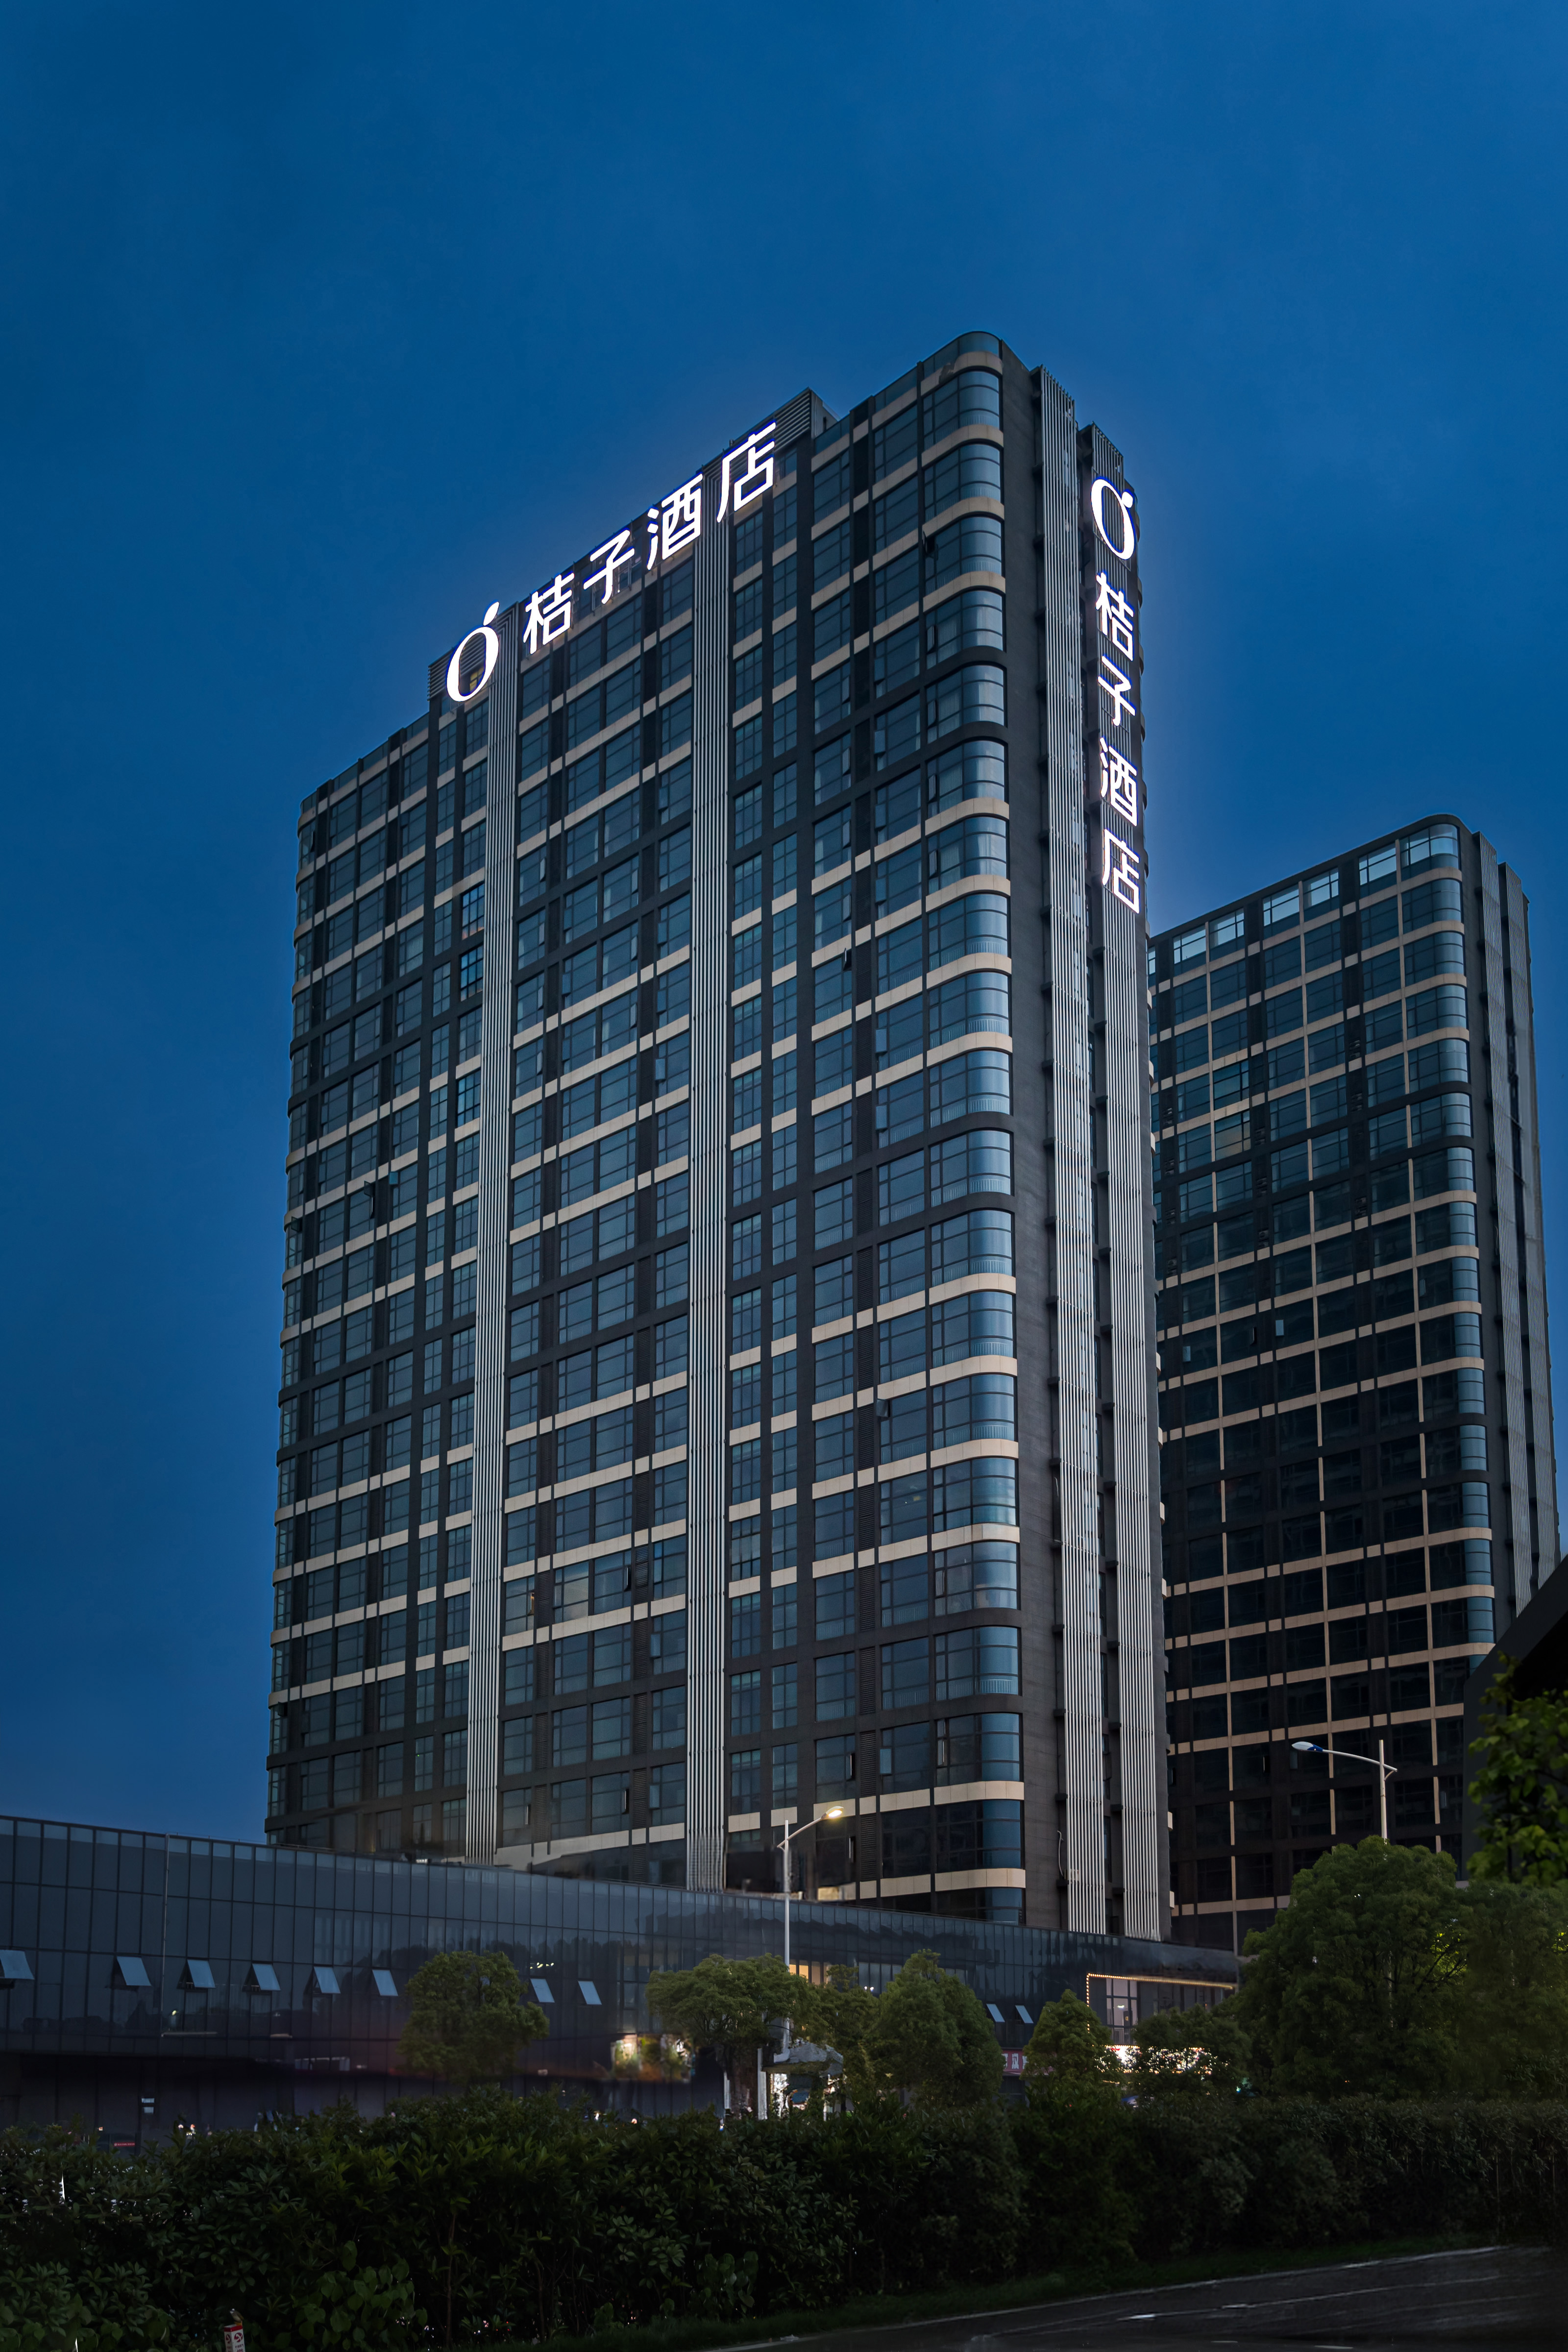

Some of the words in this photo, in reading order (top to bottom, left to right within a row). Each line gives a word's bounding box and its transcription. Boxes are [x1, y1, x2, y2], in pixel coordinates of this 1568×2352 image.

[523, 422, 776, 654] 桔子酒店
[1095, 572, 1140, 914] 桔子酒店
